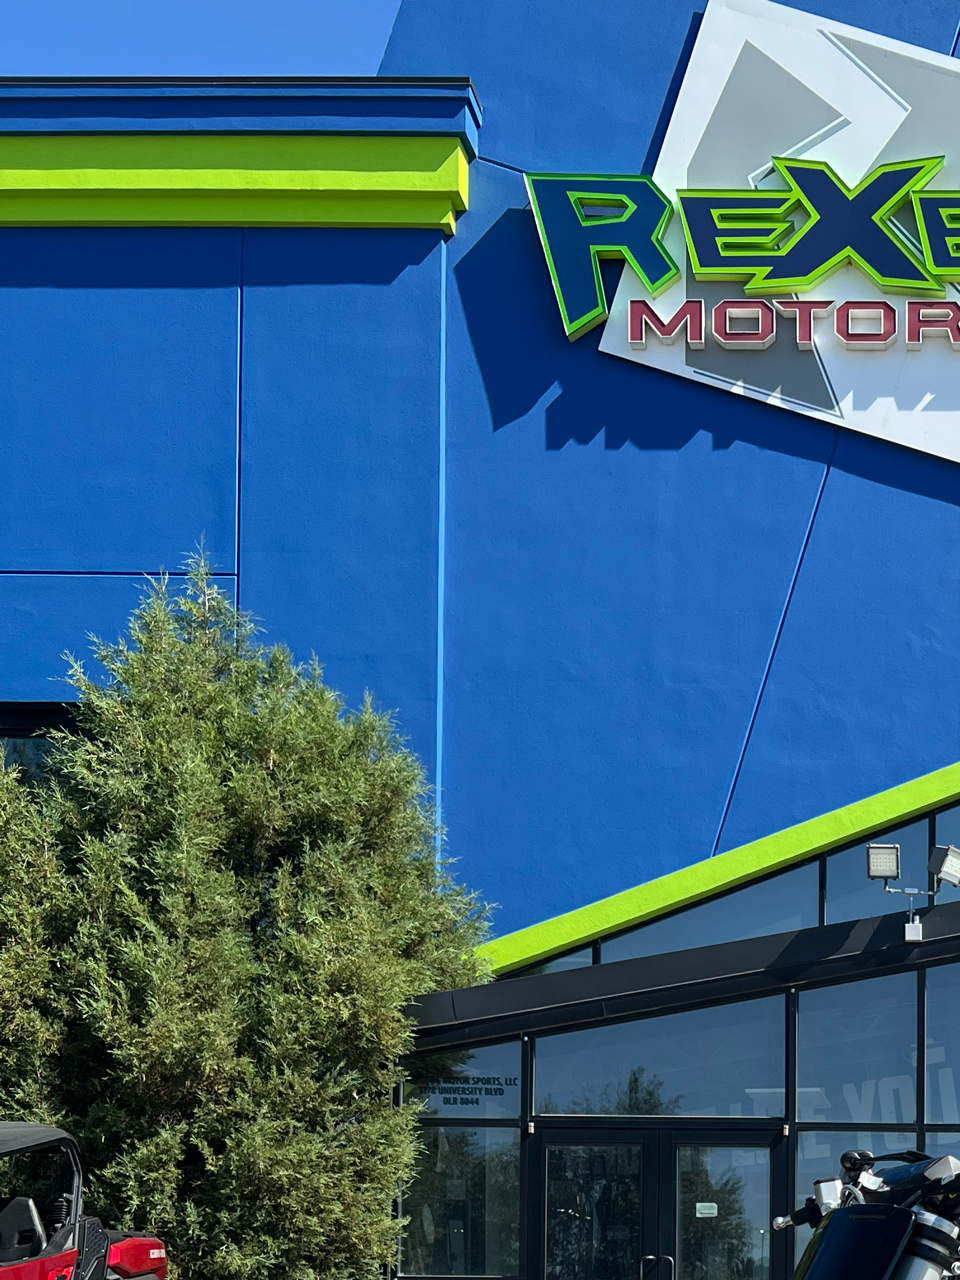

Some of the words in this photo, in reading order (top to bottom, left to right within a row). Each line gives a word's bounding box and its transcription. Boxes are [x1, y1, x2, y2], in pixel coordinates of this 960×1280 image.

[471, 1077, 503, 1086] SPORTS,
[504, 1078, 518, 1086] LLC
[438, 1087, 483, 1095] UNIVERSITY
[484, 1087, 504, 1096] BLVD
[443, 1097, 458, 1105] DLR
